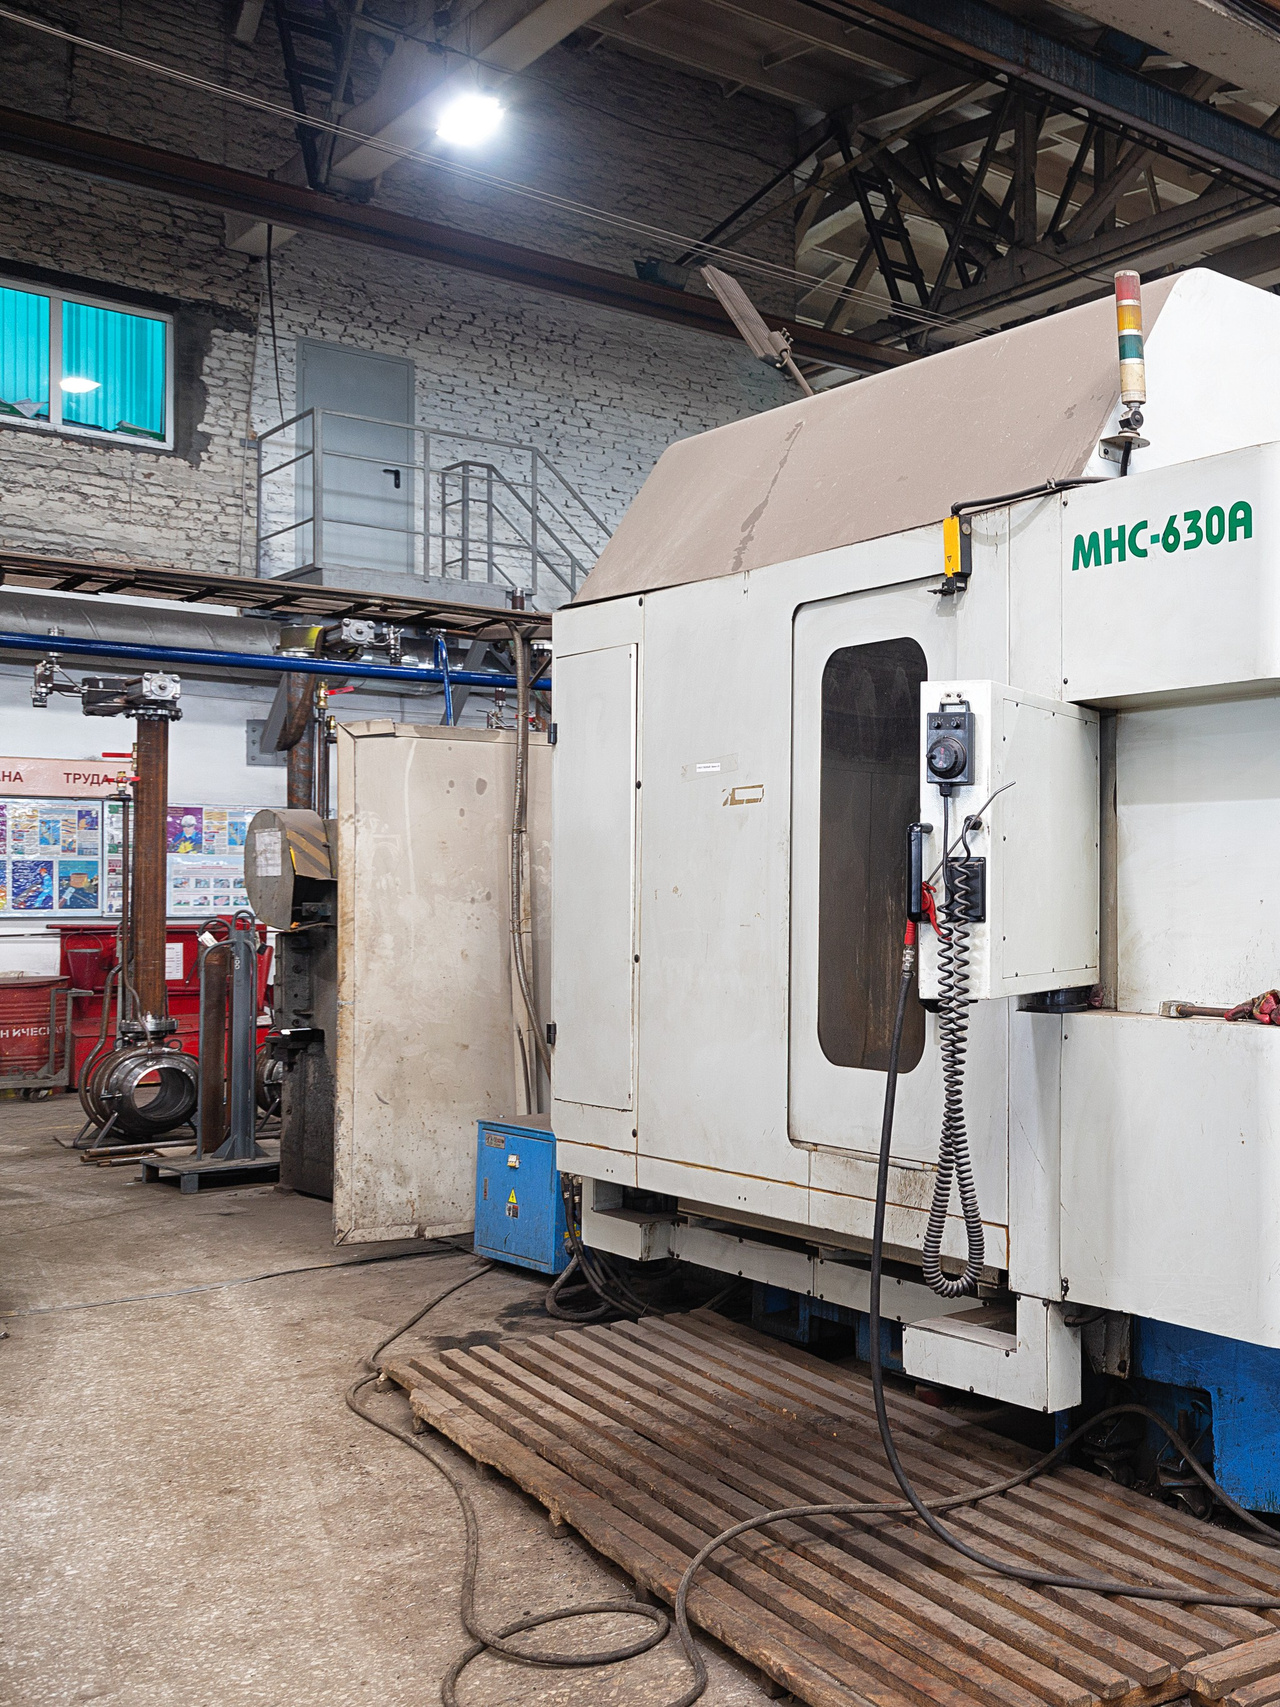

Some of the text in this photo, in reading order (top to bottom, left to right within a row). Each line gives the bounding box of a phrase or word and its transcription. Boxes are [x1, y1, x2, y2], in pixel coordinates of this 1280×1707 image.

[1072, 500, 1253, 571] MHC-630A
[0, 770, 111, 787] НА ТРУДА
